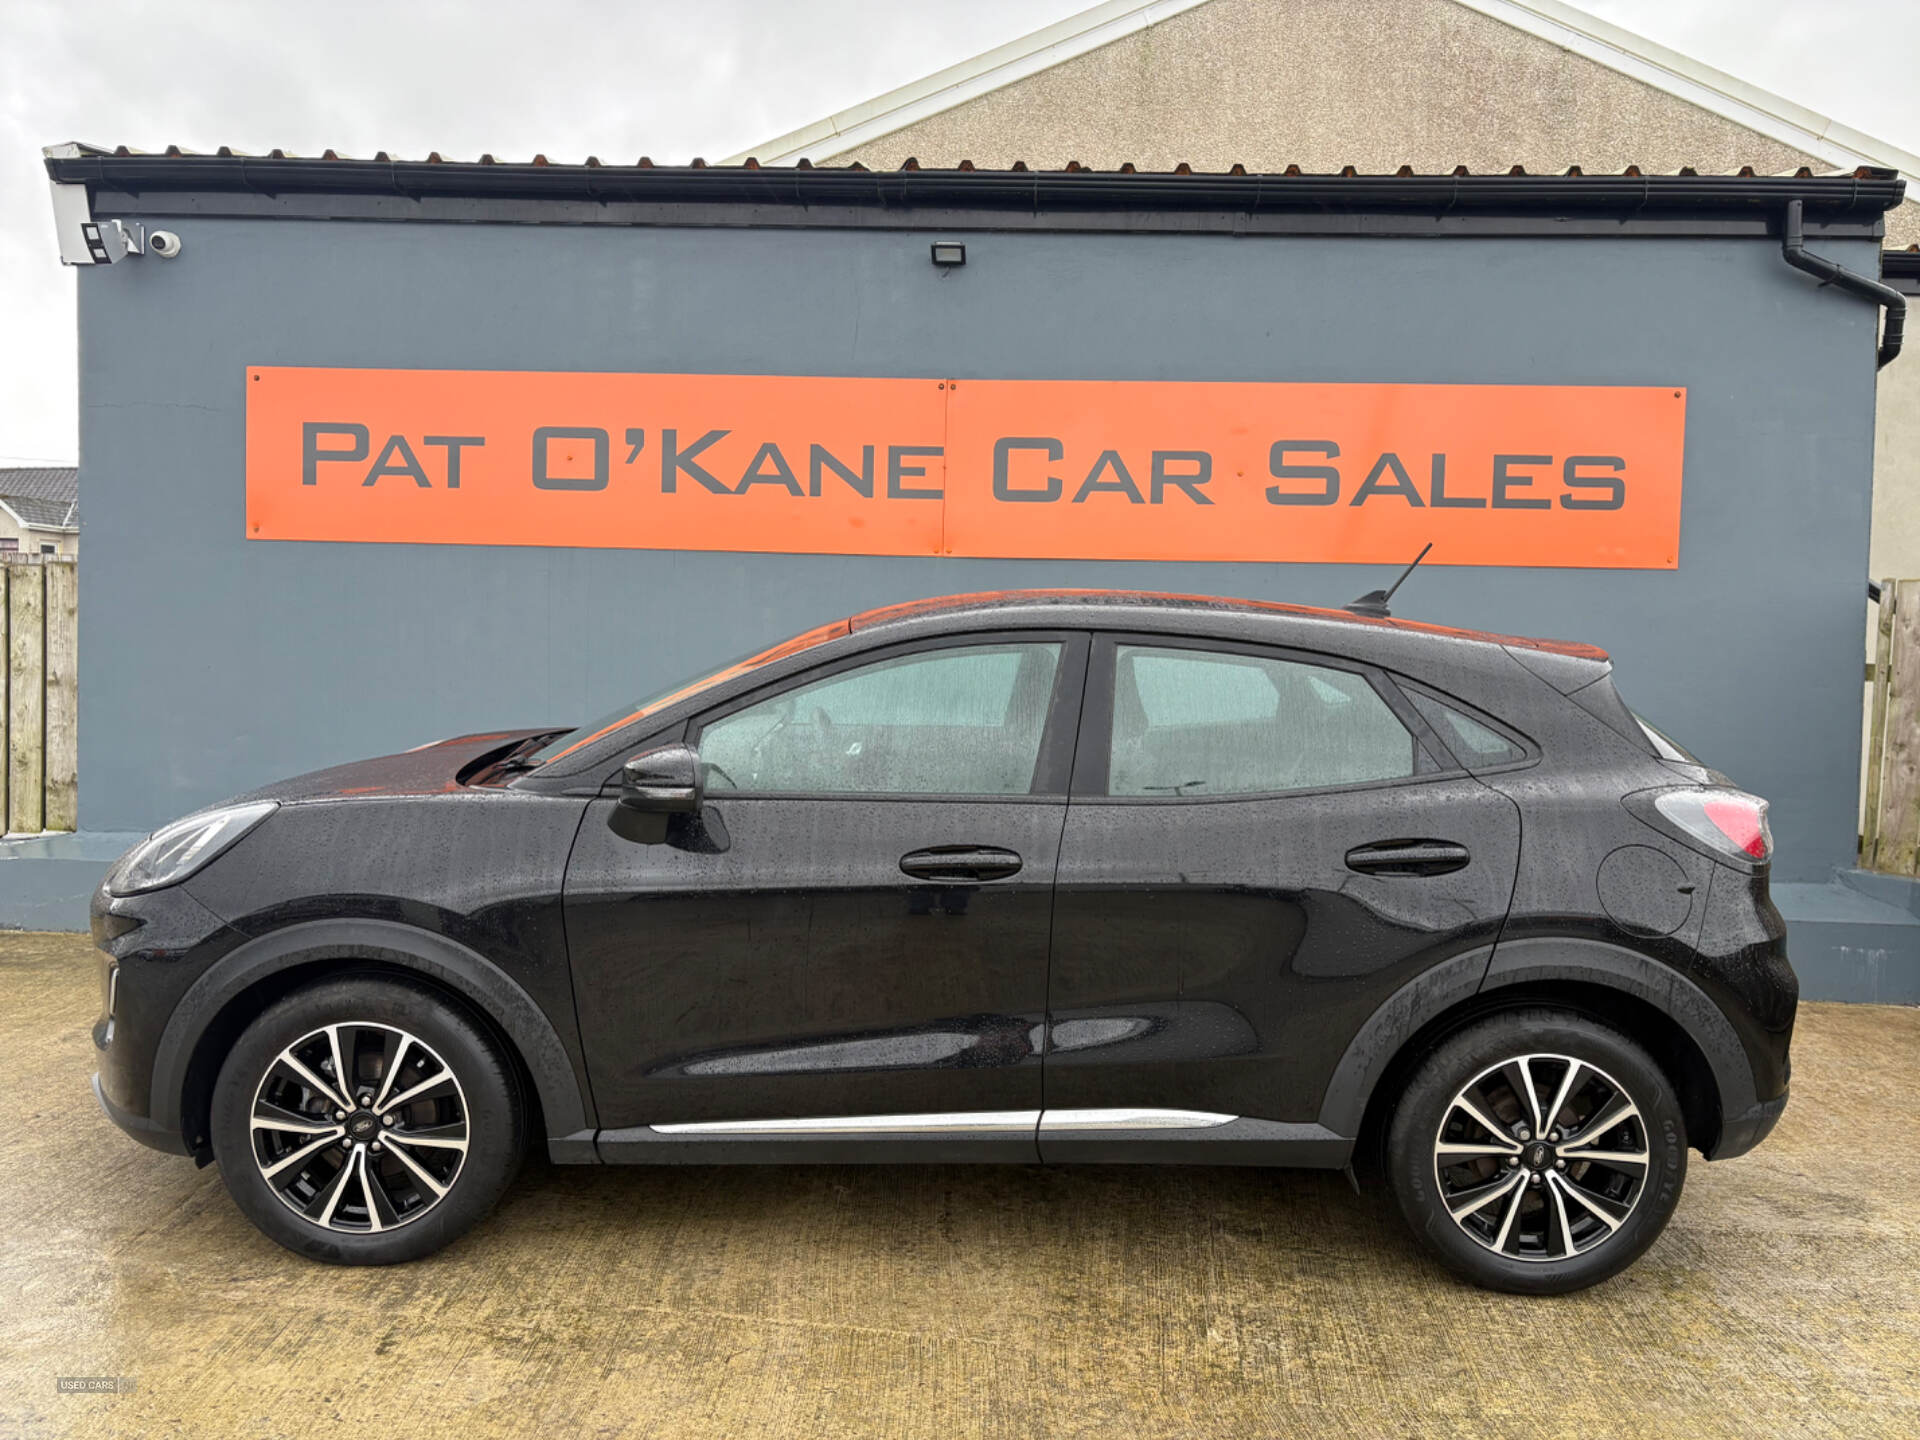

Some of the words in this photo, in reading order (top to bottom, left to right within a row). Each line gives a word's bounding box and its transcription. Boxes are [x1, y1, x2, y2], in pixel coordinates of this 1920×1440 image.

[303, 422, 486, 489] PAT
[532, 426, 945, 500] O'KANE
[992, 437, 1215, 505] CAR
[1265, 440, 1627, 511] SALES
